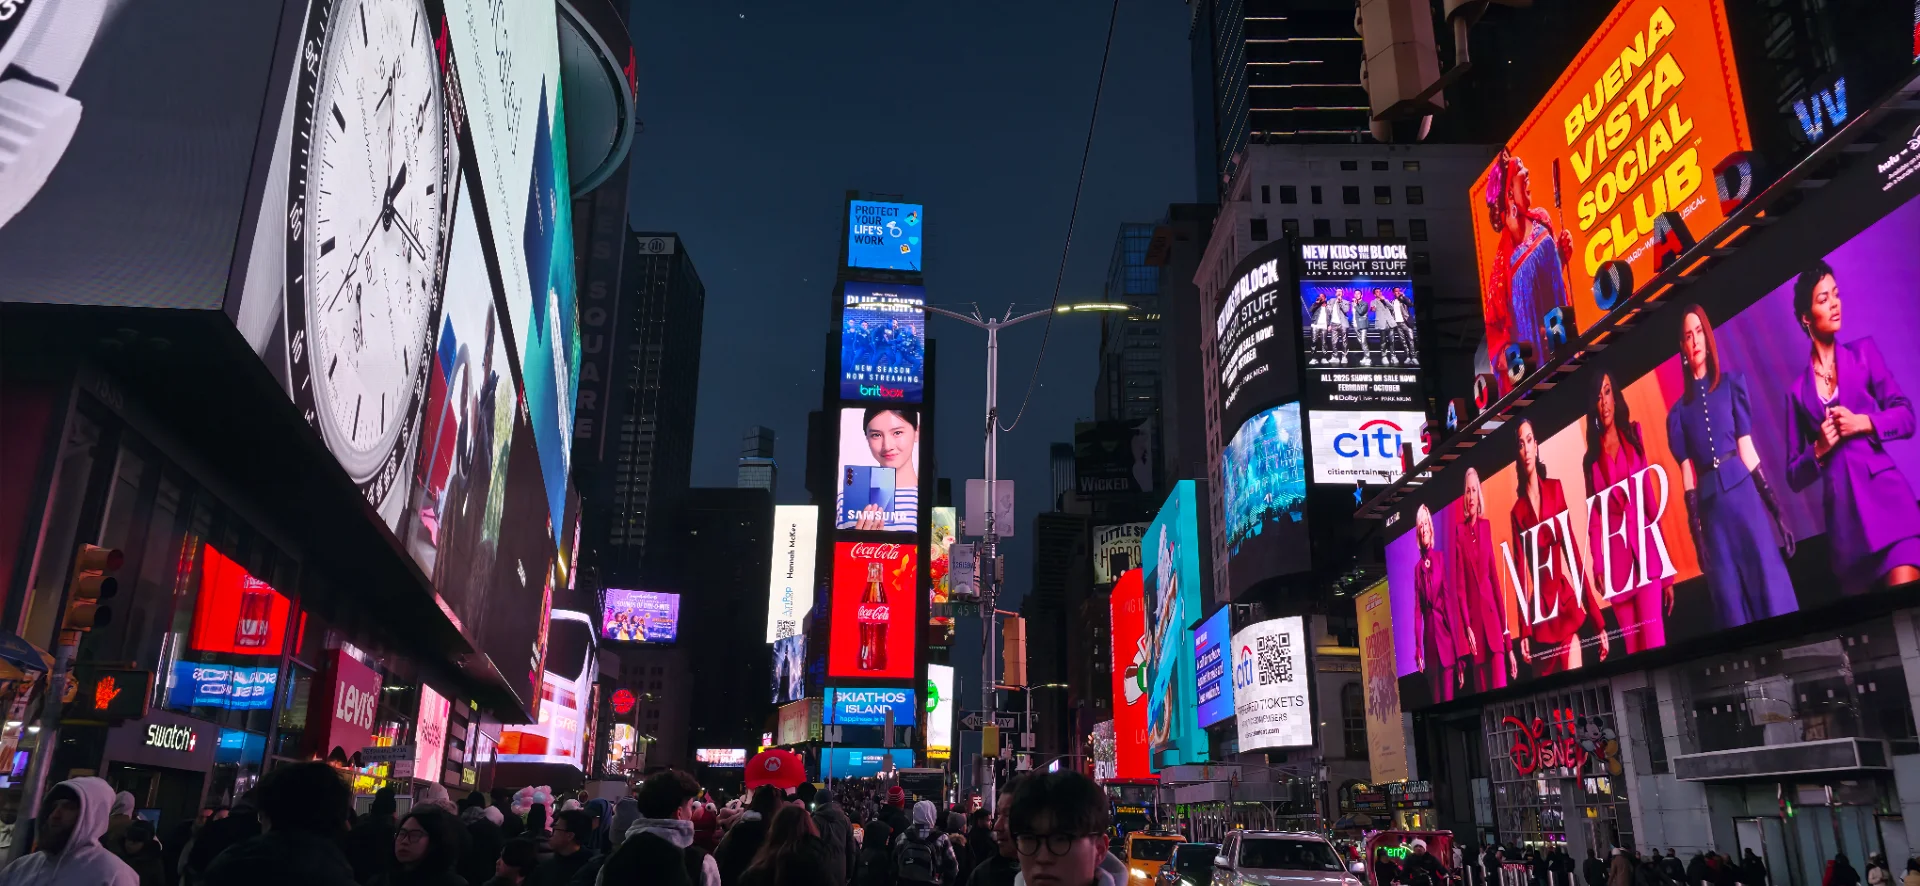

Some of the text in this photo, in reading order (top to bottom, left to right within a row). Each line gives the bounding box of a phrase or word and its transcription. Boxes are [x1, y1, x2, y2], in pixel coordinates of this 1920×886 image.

[1564, 5, 1676, 146] BUENA
[1570, 52, 1686, 184] VISTA
[1577, 103, 1694, 232] SOCIAL
[1878, 154, 1900, 173] hulu
[855, 205, 899, 217] PROTECT
[1584, 147, 1703, 278] CLUB
[855, 215, 882, 225] YOUR
[854, 224, 883, 235] LIFE'S
[854, 235, 884, 246] WORK
[1302, 245, 1329, 260] NEW
[1329, 245, 1358, 260] KIDS
[1370, 245, 1407, 260] BLOCK
[1305, 261, 1407, 270] THE RIGHT STUFF
[1239, 259, 1279, 300] BLOCK
[1241, 290, 1278, 322] STUFF
[855, 364, 911, 374] NEW SEASON
[846, 372, 919, 383] NOW STREAMING
[1321, 374, 1332, 382] ALL
[1383, 374, 1399, 382] SALE
[859, 384, 904, 398] britbox
[1373, 384, 1400, 392] OCTOBER
[1338, 394, 1359, 403] Dolby
[1333, 427, 1402, 459] citi
[847, 509, 908, 521] SAMSUNG
[1100, 526, 1132, 545] LITTLE
[786, 523, 797, 579] Hannah McKee
[850, 542, 901, 560] Coca-Cola
[1500, 464, 1677, 635] NEVER
[857, 606, 890, 620] Coca-Cola
[944, 605, 953, 616] W
[957, 604, 970, 617] 45
[1236, 653, 1254, 690] citi
[836, 691, 906, 703] SKIATHOS
[1261, 694, 1305, 711] TICKETS
[845, 704, 892, 714] ISLAND
[967, 714, 984, 727] ONE
[146, 724, 190, 751] swatch
